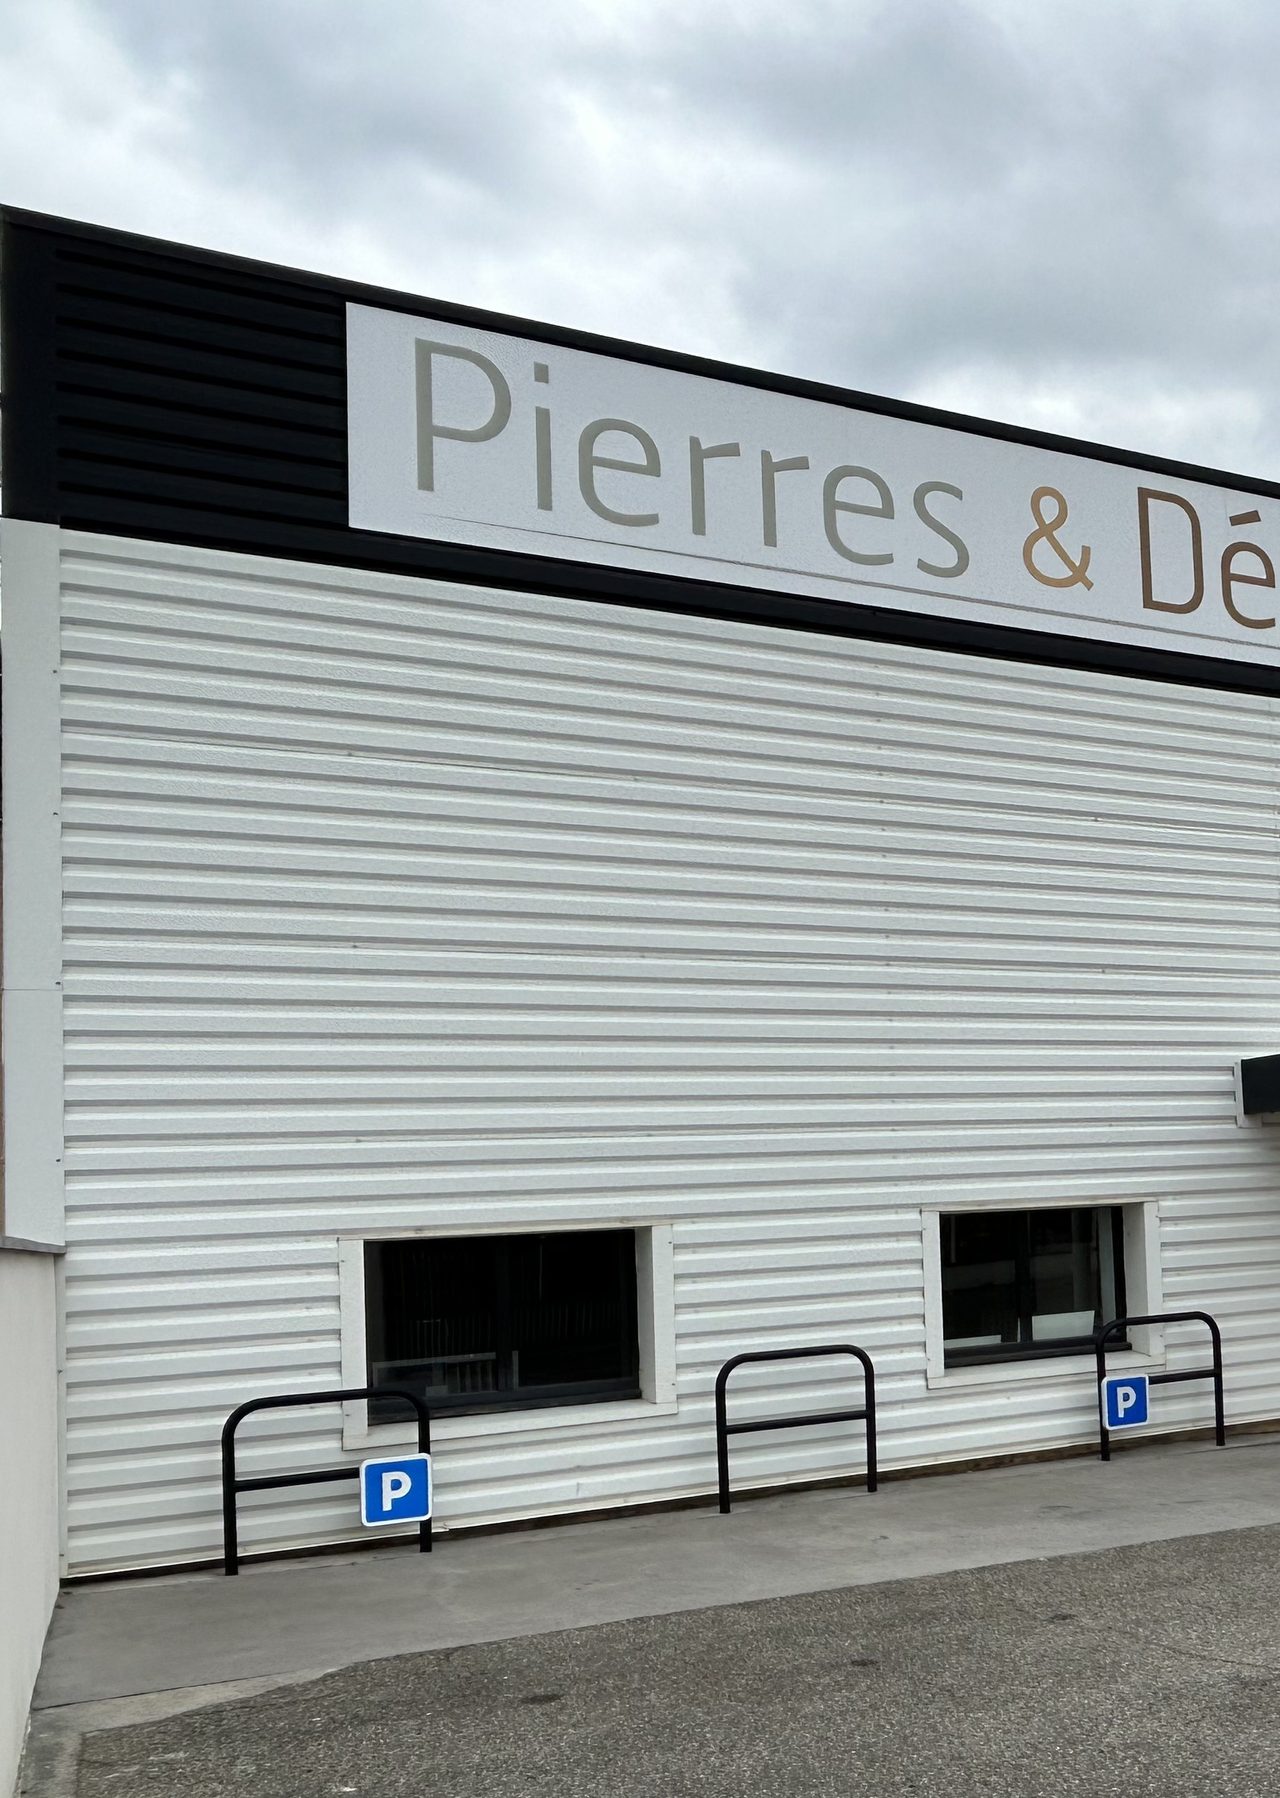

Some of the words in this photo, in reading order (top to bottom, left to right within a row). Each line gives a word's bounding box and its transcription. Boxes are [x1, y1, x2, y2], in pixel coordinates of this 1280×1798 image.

[415, 337, 970, 578] Pierres
[1023, 486, 1094, 591] &
[1116, 1386, 1136, 1418] P
[381, 1471, 411, 1511] P
